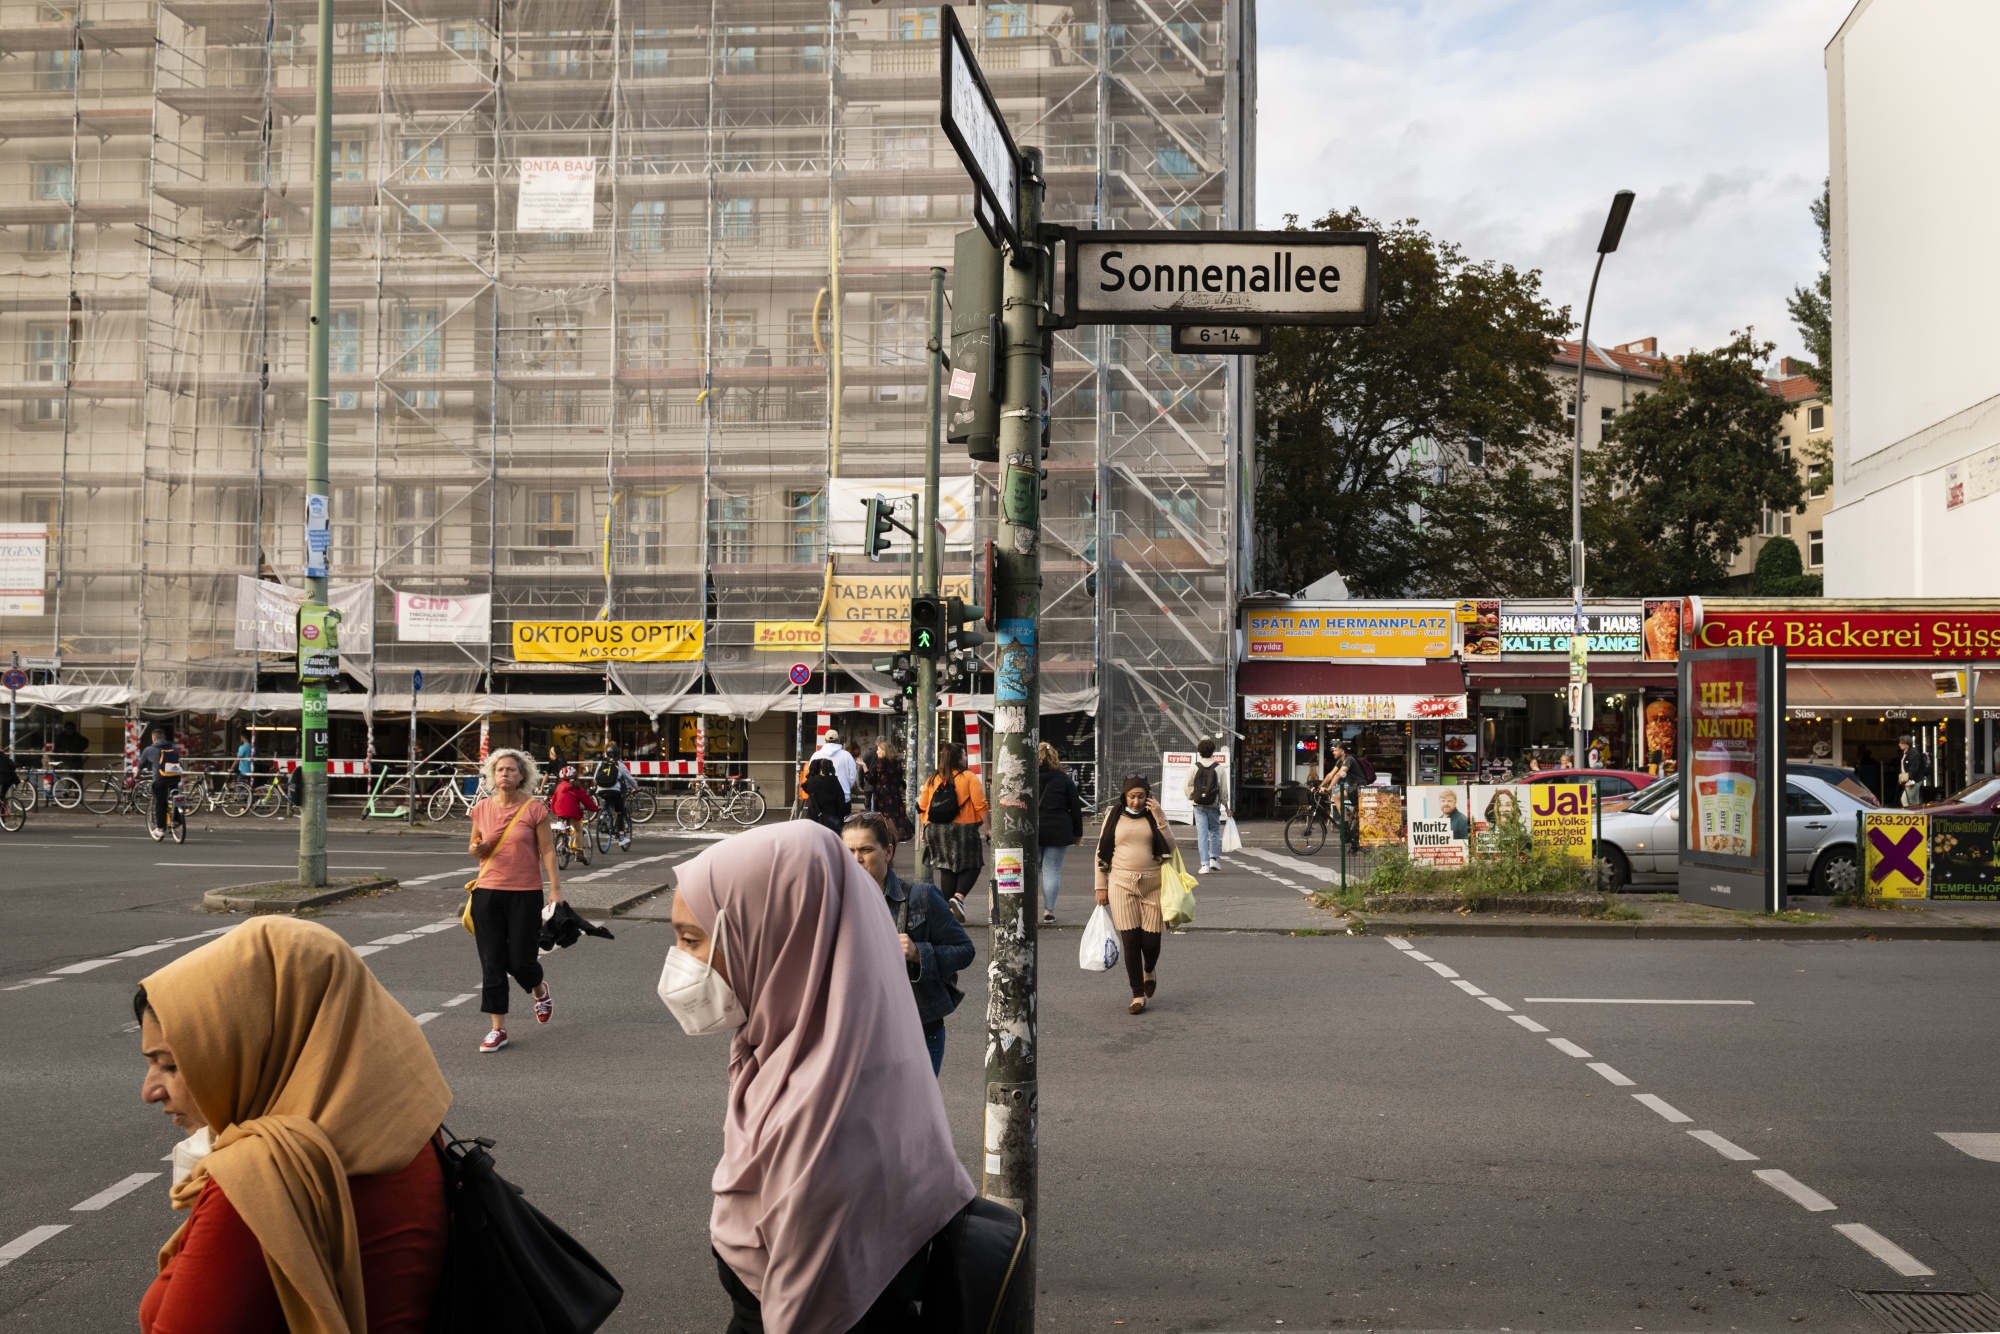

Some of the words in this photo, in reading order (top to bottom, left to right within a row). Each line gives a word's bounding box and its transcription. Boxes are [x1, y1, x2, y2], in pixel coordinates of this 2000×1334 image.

[523, 160, 560, 172] ONTA
[564, 160, 594, 172] BAU
[1100, 251, 1341, 293] Sonnenallee
[1200, 329, 1241, 343] 6-14
[832, 584, 969, 600] TABAKWEN
[408, 596, 449, 611] GM
[847, 604, 911, 620] GETRÄ
[1252, 616, 1293, 629] SPÄTI
[1299, 618, 1320, 629] AM
[1326, 618, 1447, 629] HERMANNPLATZ
[1602, 616, 1638, 632] HAUS
[519, 626, 623, 643] OKTOPUS
[631, 625, 696, 642] OPTIK
[778, 629, 821, 643] LOTTO
[1701, 621, 1775, 647] Café
[1784, 621, 1923, 647] Bäckerei
[1503, 636, 1550, 651] KALTE
[579, 647, 637, 657] MOSCOT
[303, 656, 330, 666] braucht
[1261, 703, 1284, 712] 0,80
[1287, 703, 1295, 711] €
[1422, 703, 1445, 712] 0,80
[1795, 709, 1815, 718] Süss
[1885, 709, 1907, 718] Café
[1697, 719, 1755, 738] NATUR
[1533, 785, 1588, 816] Ja!
[1413, 821, 1448, 832] Moritz
[1558, 817, 1589, 826] Volks-
[1867, 816, 1924, 826] 26.9.2021
[1934, 820, 1991, 833] Theater
[1533, 827, 1586, 836] entscheid
[1413, 834, 1450, 845] Wittler
[1869, 887, 1883, 896] Ja!
